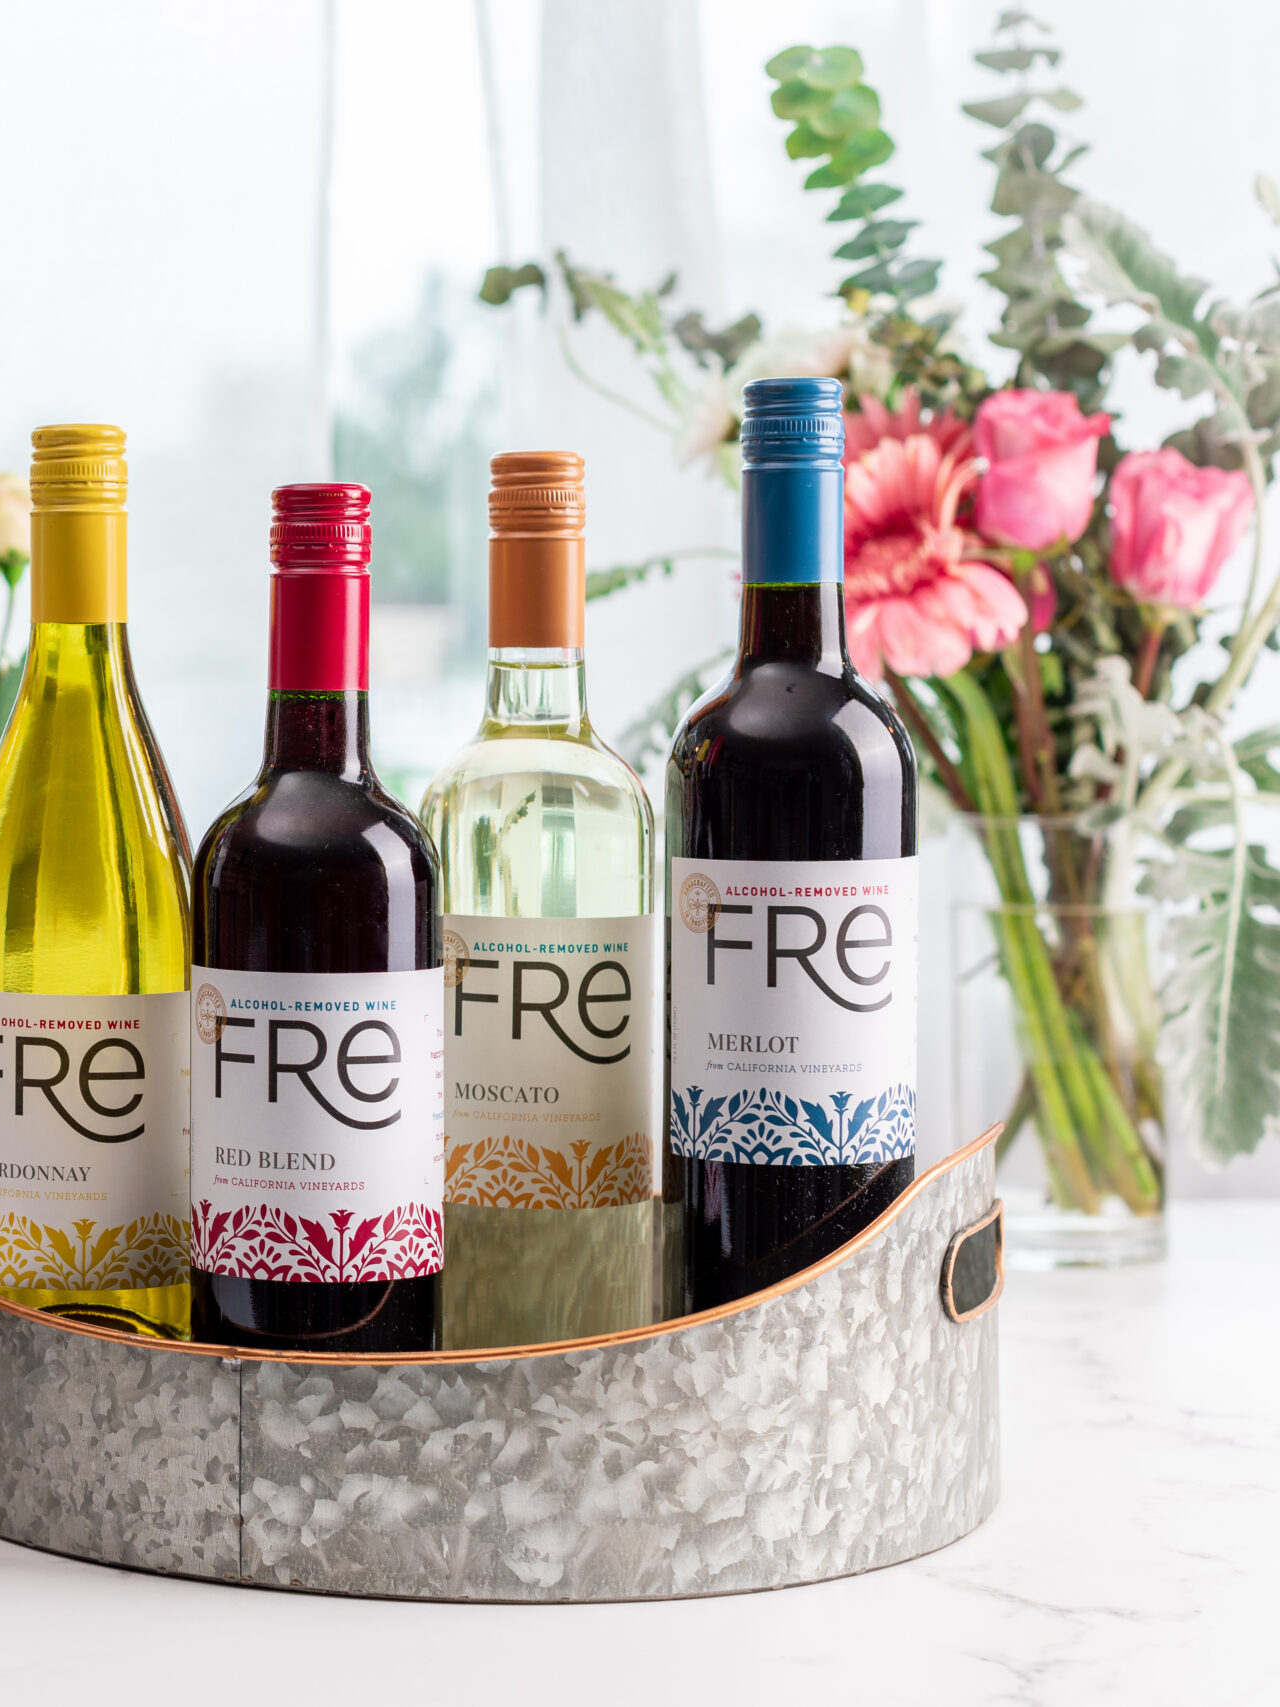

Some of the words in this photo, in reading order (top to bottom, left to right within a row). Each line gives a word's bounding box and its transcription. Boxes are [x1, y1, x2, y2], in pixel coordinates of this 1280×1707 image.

[725, 885, 858, 897] ALCOHOL-REMOVED
[862, 885, 889, 896] WINE
[473, 941, 599, 954] ALCOHOL-REMOVED
[603, 942, 629, 953] WINE
[230, 998, 360, 1011] ALCOHOL-REMOVED
[365, 1000, 397, 1010] WINE
[107, 1020, 140, 1029] WINE
[707, 1032, 799, 1053] MERLOT
[705, 1060, 724, 1071] from
[727, 1062, 797, 1073] CALIFORNIA
[800, 1063, 863, 1073] VINEYARDS
[454, 1082, 560, 1104] MOSCATO
[472, 1111, 539, 1123] CALIFORNIA
[542, 1112, 601, 1123] VINEYARDS
[215, 1146, 251, 1167] RED
[259, 1151, 336, 1171] BLEND
[213, 1174, 229, 1186] from
[231, 1177, 296, 1191] CALIFORNIA
[300, 1181, 365, 1191] VINEYARDS
[44, 1191, 107, 1201] VINEYARDS
